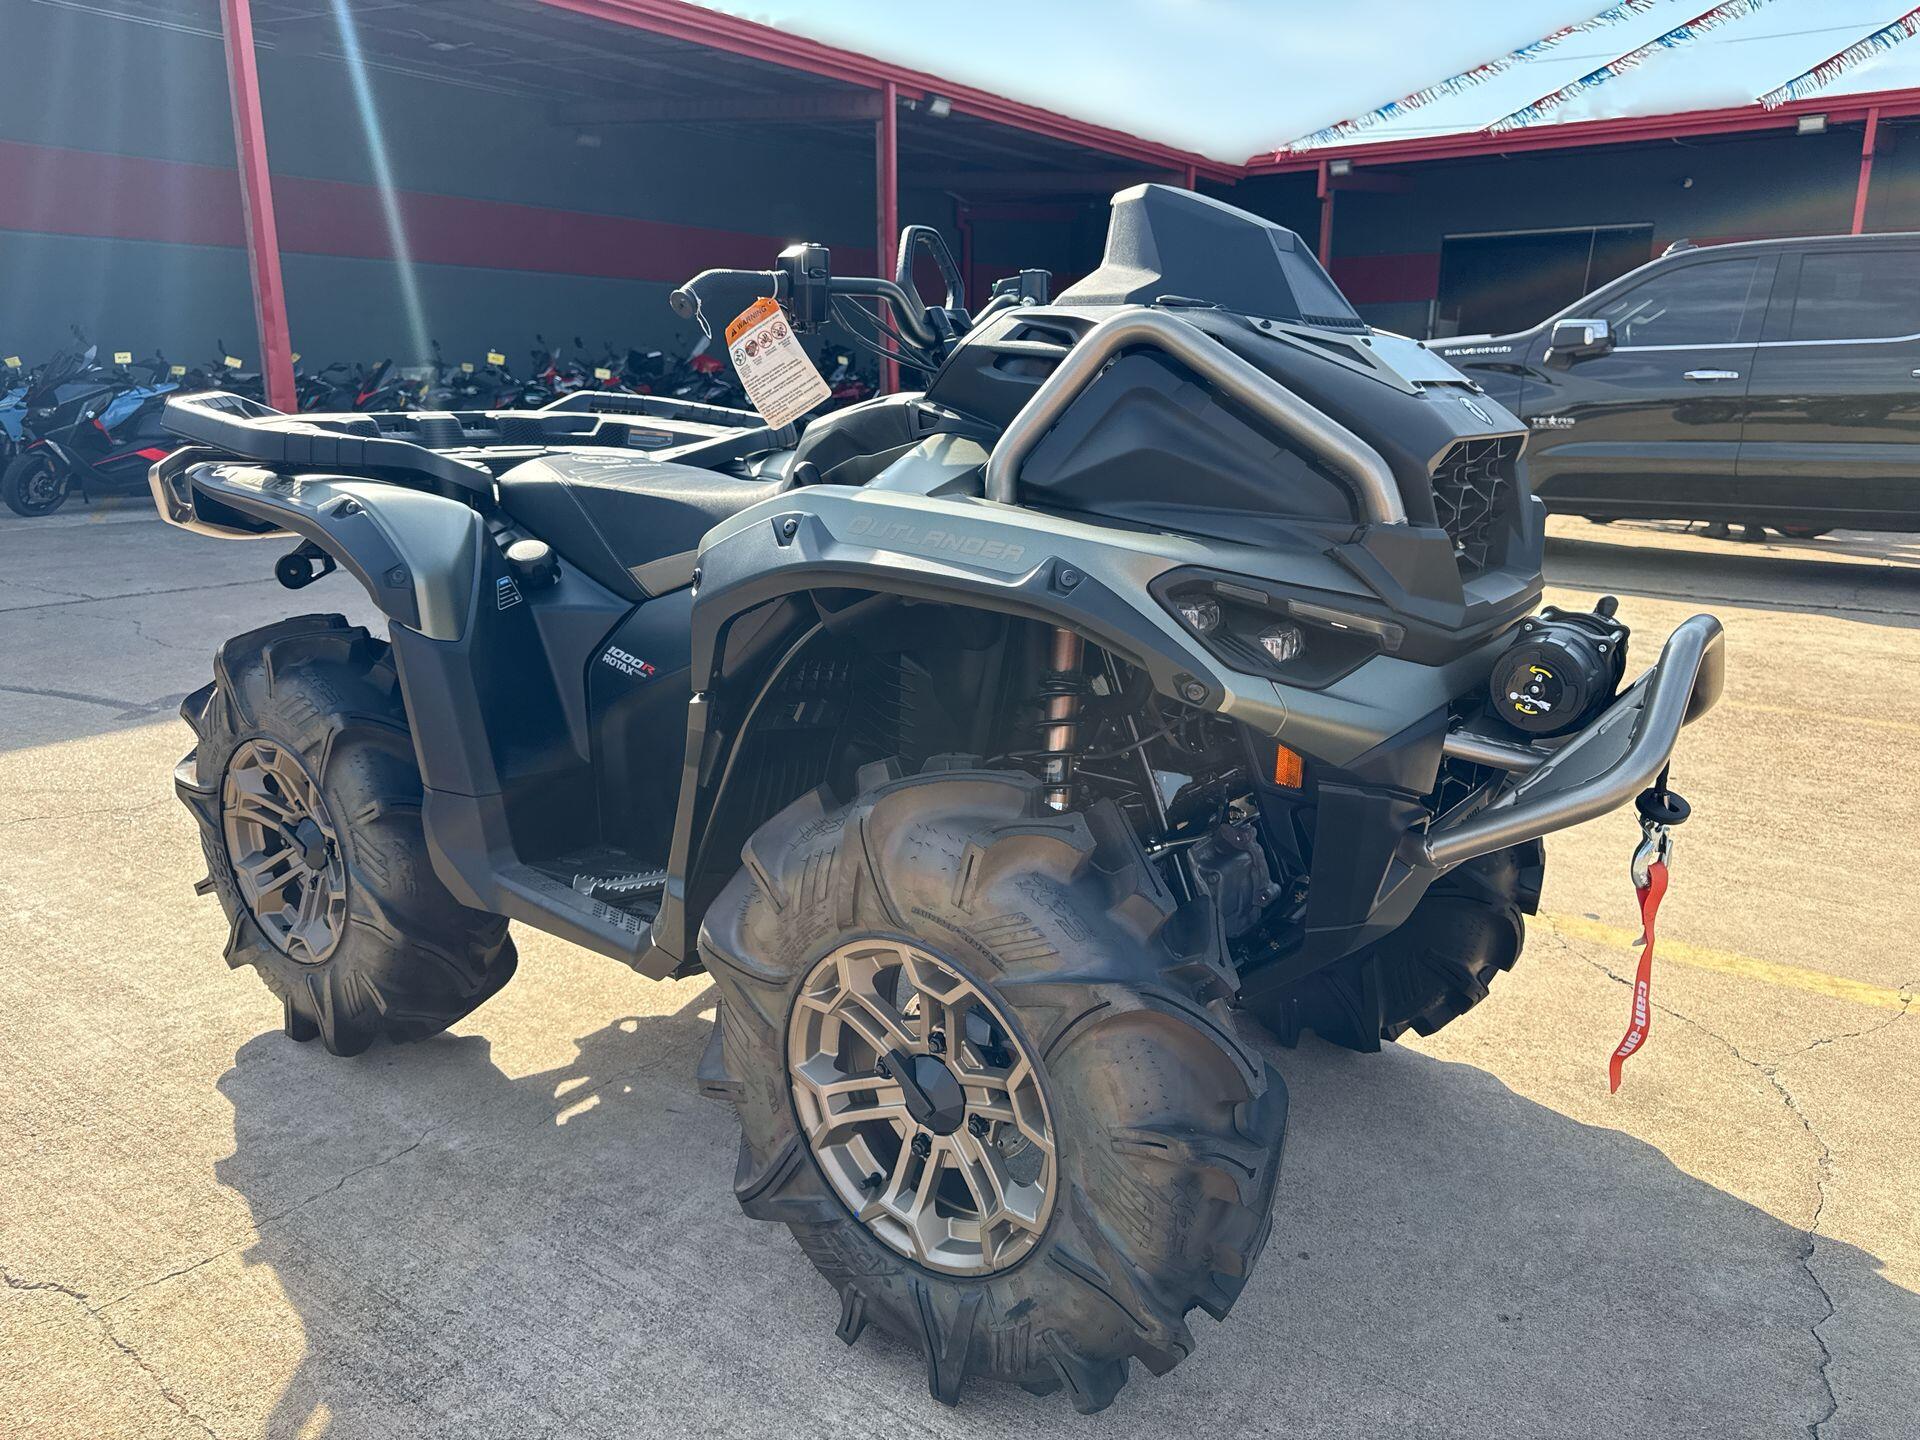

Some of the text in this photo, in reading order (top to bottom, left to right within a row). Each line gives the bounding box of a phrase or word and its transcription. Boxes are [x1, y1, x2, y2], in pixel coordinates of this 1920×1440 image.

[737, 305, 767, 330] WARNING
[848, 515, 1025, 561] OUTLANDER
[602, 653, 635, 676] ROTAX
[607, 646, 656, 675] 1000R
[1616, 980, 1648, 1057] can-am
